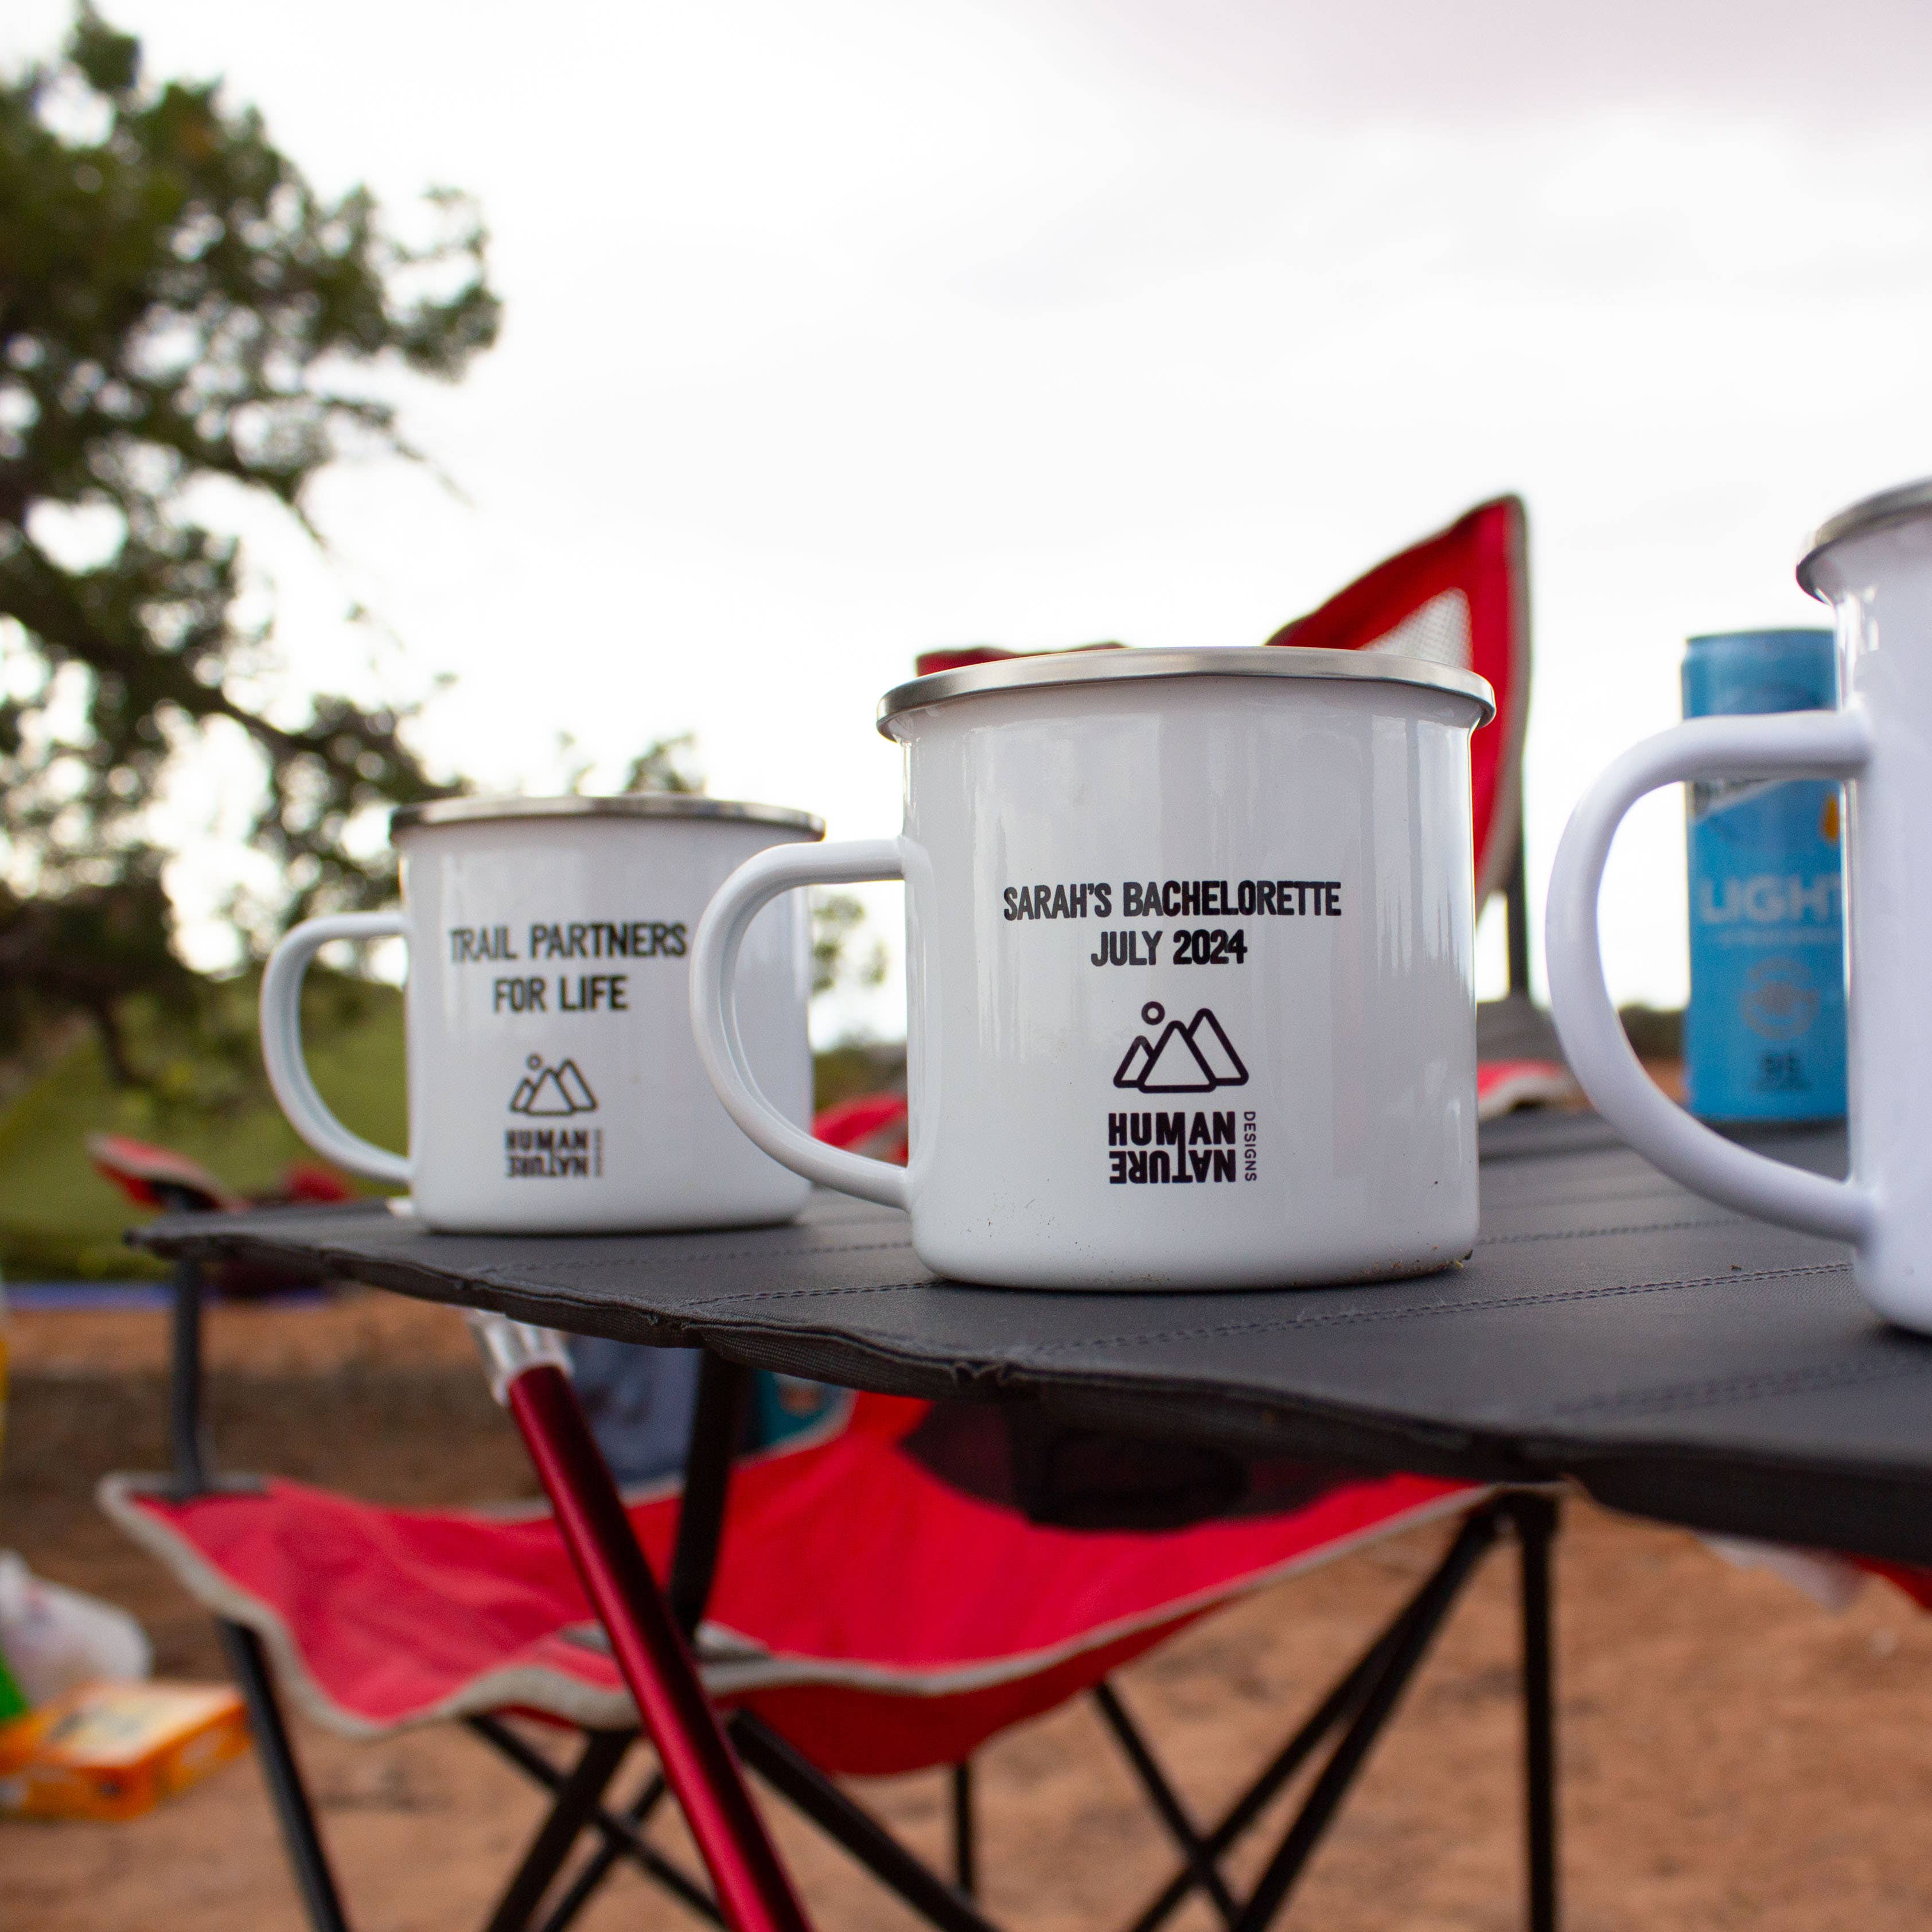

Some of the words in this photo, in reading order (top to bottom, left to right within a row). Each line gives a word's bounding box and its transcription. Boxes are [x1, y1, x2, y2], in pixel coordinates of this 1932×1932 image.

[1003, 882, 1112, 921] SARAH'S
[1123, 880, 1341, 917] BACHELORETTE
[450, 924, 517, 963] TRAIL
[530, 922, 687, 960] PARTNERS
[1090, 930, 1163, 967] JULY
[1173, 929, 1247, 965] 2024
[493, 975, 547, 1012] FOR
[558, 973, 629, 1011] LIFE
[1108, 1111, 1236, 1146] HUMAN
[1243, 1111, 1257, 1182] DESIGNS
[1109, 1149, 1236, 1184] NATURE
